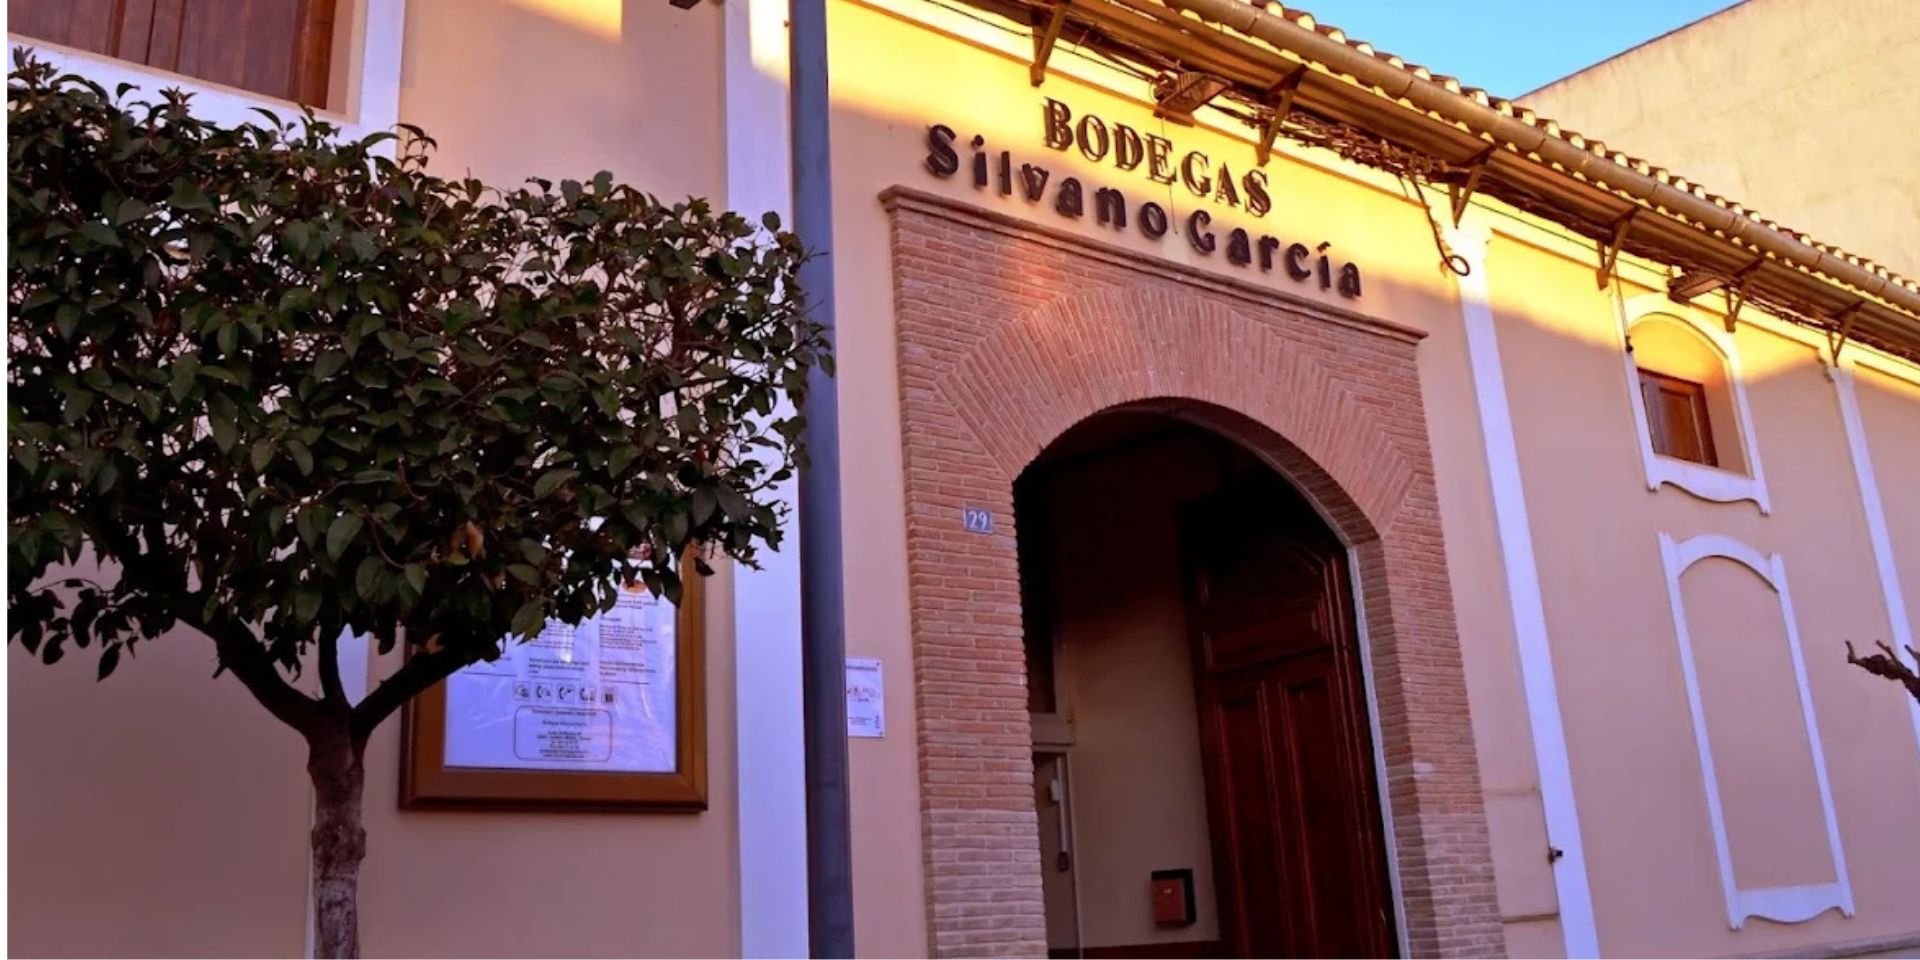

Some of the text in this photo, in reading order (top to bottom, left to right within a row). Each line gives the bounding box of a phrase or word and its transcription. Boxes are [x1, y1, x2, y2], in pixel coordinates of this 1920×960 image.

[924, 123, 1363, 298] Silvano García
[1042, 96, 1273, 218] BODEGAS
[968, 510, 989, 530] 29
